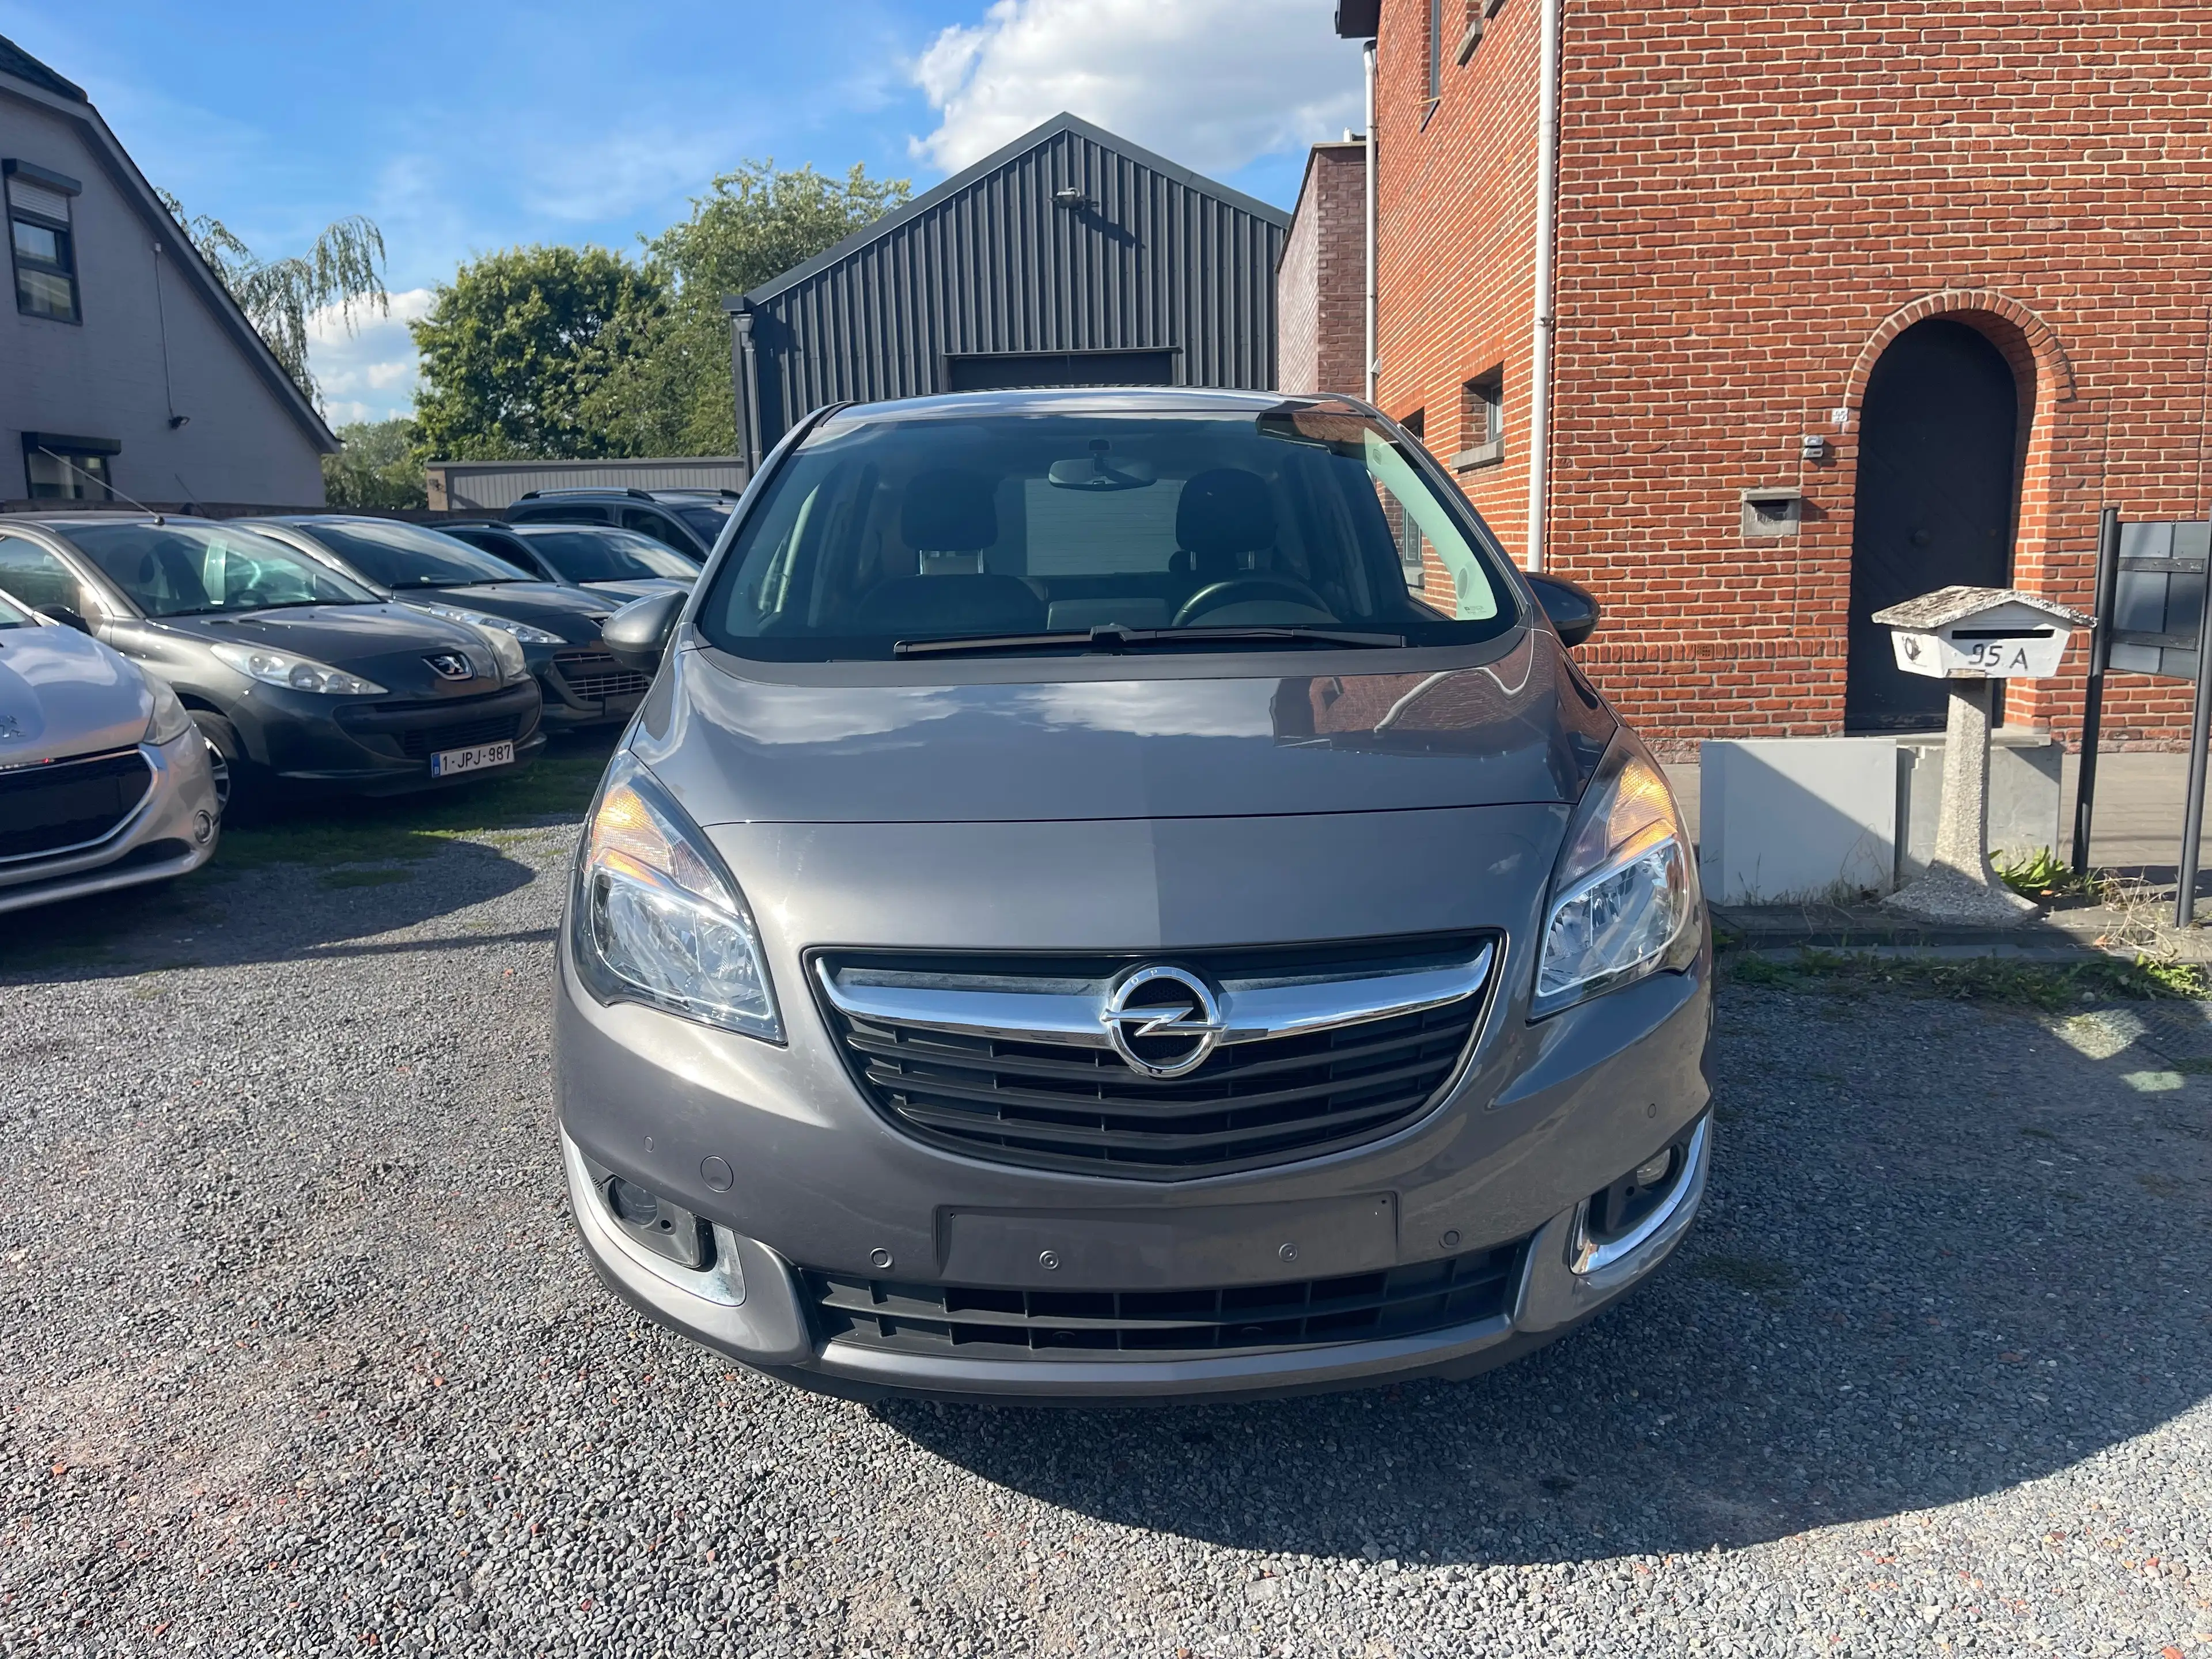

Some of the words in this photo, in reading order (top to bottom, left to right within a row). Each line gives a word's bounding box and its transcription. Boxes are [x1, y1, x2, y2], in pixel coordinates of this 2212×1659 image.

[1968, 643, 2003, 667] 95
[2009, 647, 2029, 672] A
[442, 744, 511, 771] 1-JPJ-987
